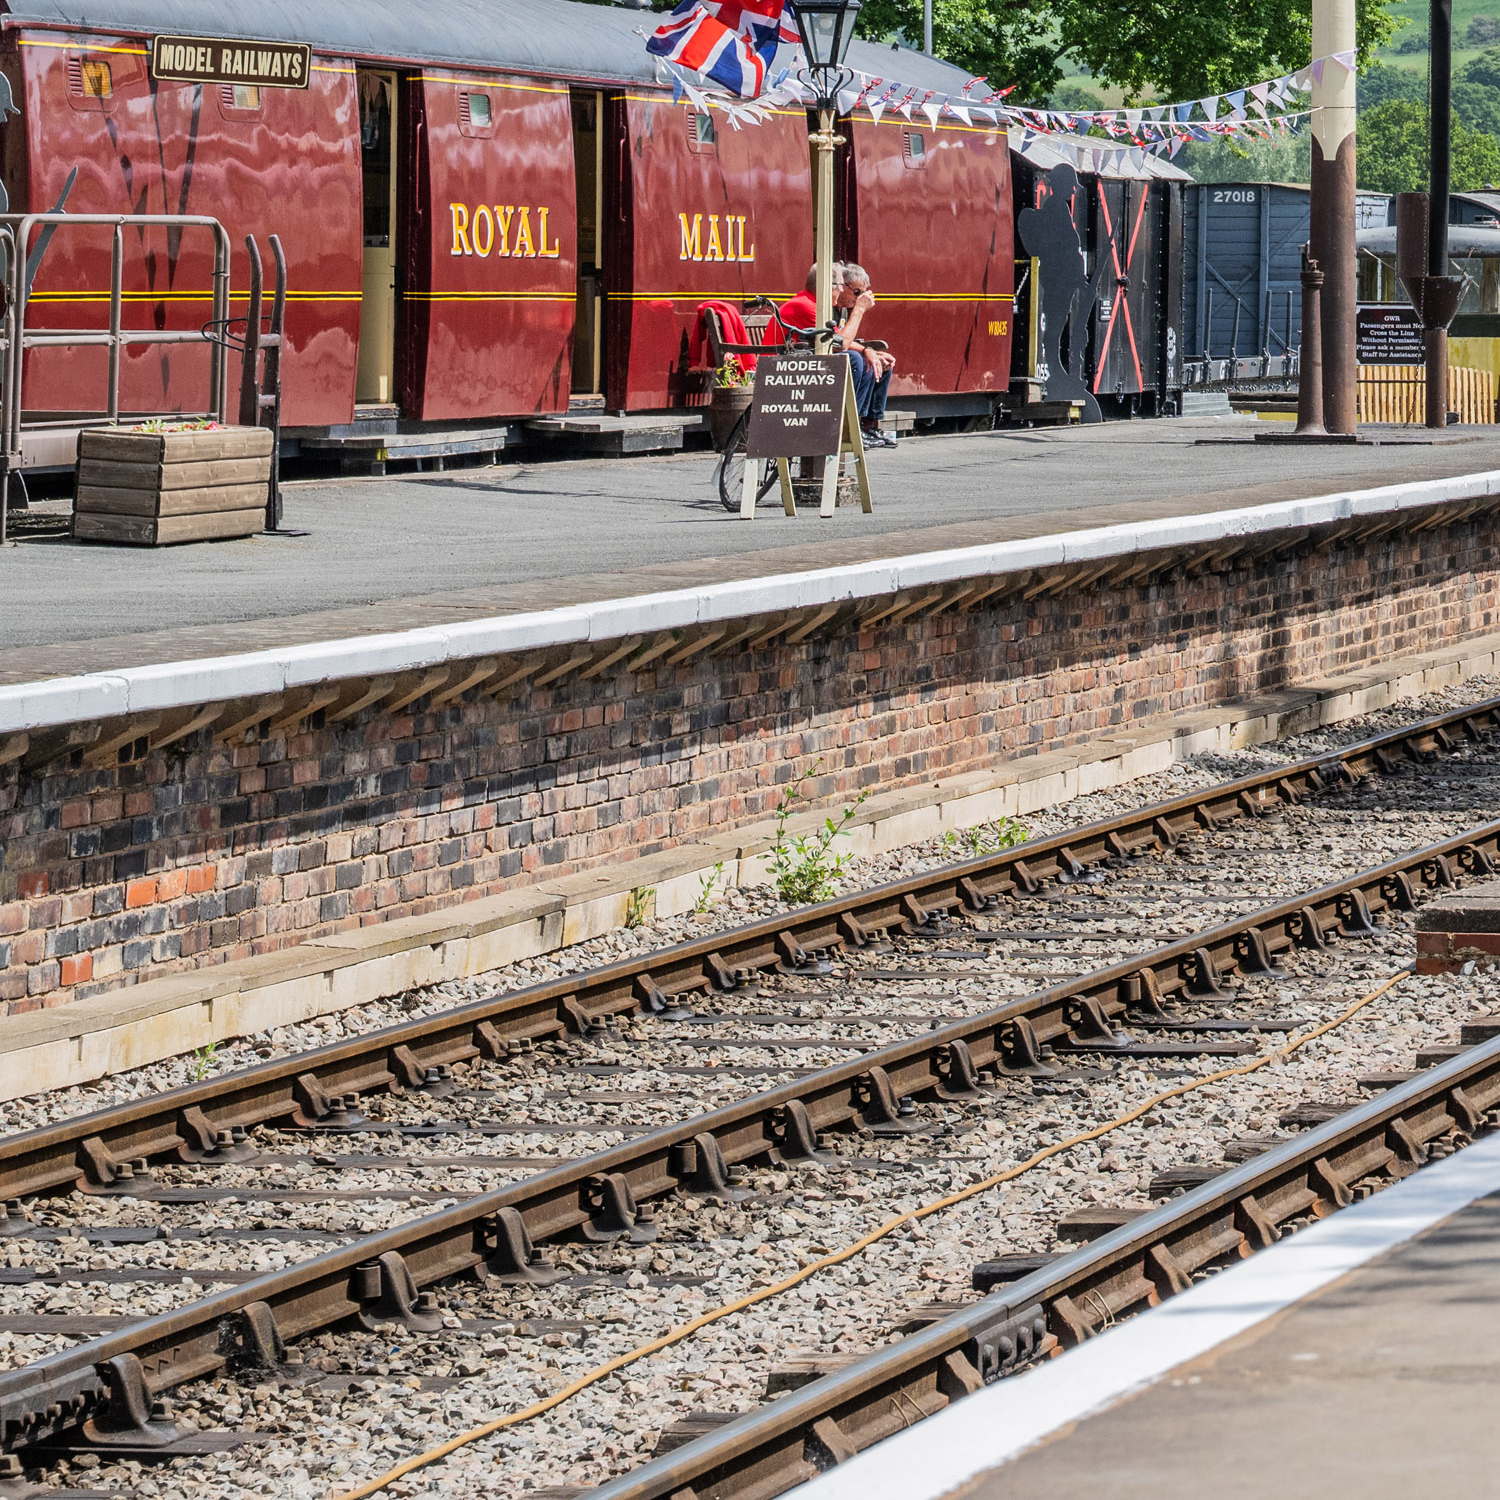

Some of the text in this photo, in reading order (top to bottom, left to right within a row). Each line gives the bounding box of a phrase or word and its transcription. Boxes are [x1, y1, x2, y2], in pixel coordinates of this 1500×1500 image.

[160, 44, 302, 79] MODEL RAILWAYS
[1213, 191, 1256, 203] 27018
[450, 203, 755, 262] ROYAL MAIL
[775, 360, 826, 372] MODEL
[764, 374, 836, 386] RAILWAYS
[791, 389, 805, 400] IN
[760, 403, 832, 413] ROYAL MAIL
[783, 417, 808, 427] VAN
